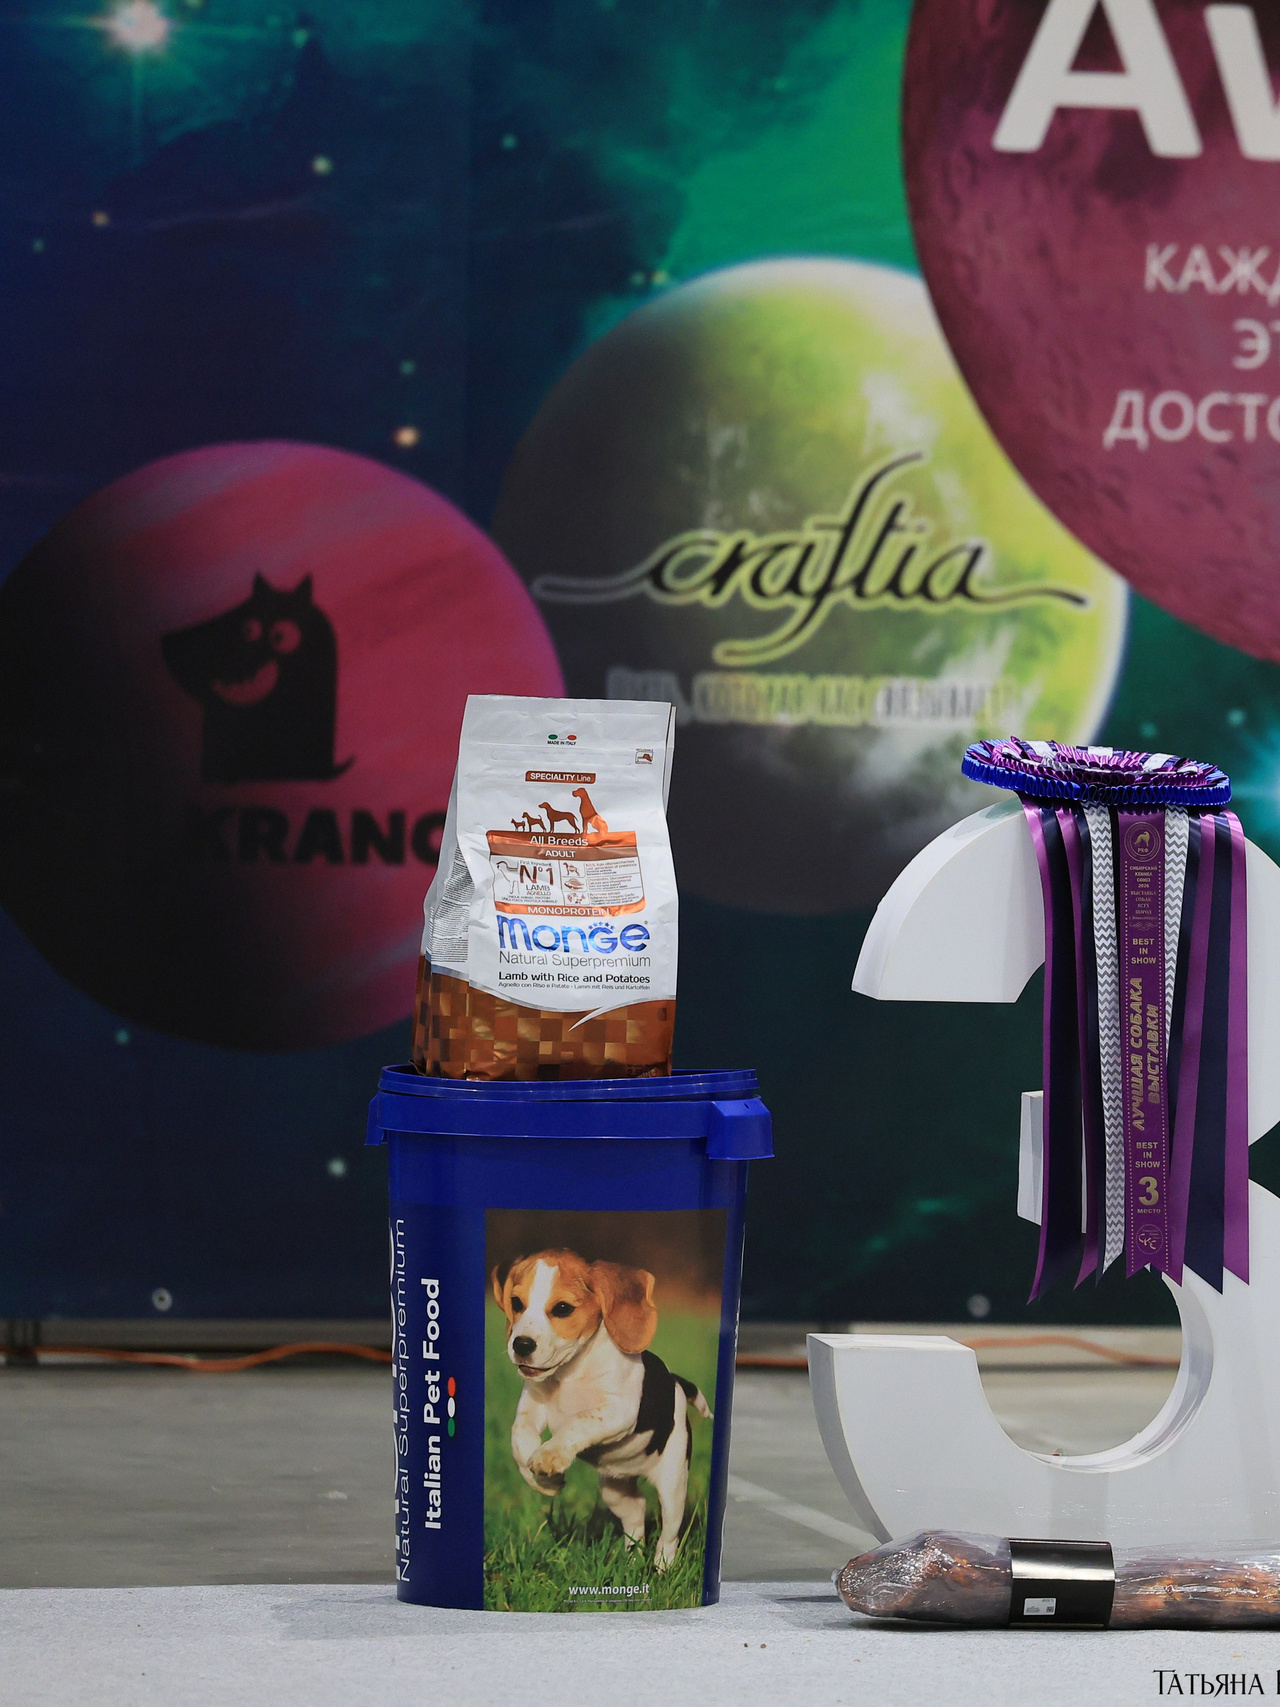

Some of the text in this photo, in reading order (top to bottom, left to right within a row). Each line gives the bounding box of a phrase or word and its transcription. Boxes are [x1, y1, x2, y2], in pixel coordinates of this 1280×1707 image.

[530, 773, 575, 782] SPECIALITY
[530, 835, 589, 846] All Breeds
[528, 906, 610, 916] MONOPROTEIN
[499, 951, 650, 969] Natural Superpremium
[498, 971, 650, 984] Lamb with Rice and Potatoes
[1130, 978, 1145, 1131] ЛУЧШАЯ СОБАКА
[1147, 1004, 1160, 1104] ВЫСТАВКИ
[1139, 1176, 1159, 1206] 3
[395, 1219, 410, 1582] Natural Superpremium
[421, 1278, 441, 1529] Italian Pet Food
[569, 1583, 650, 1597] www.monge.it
